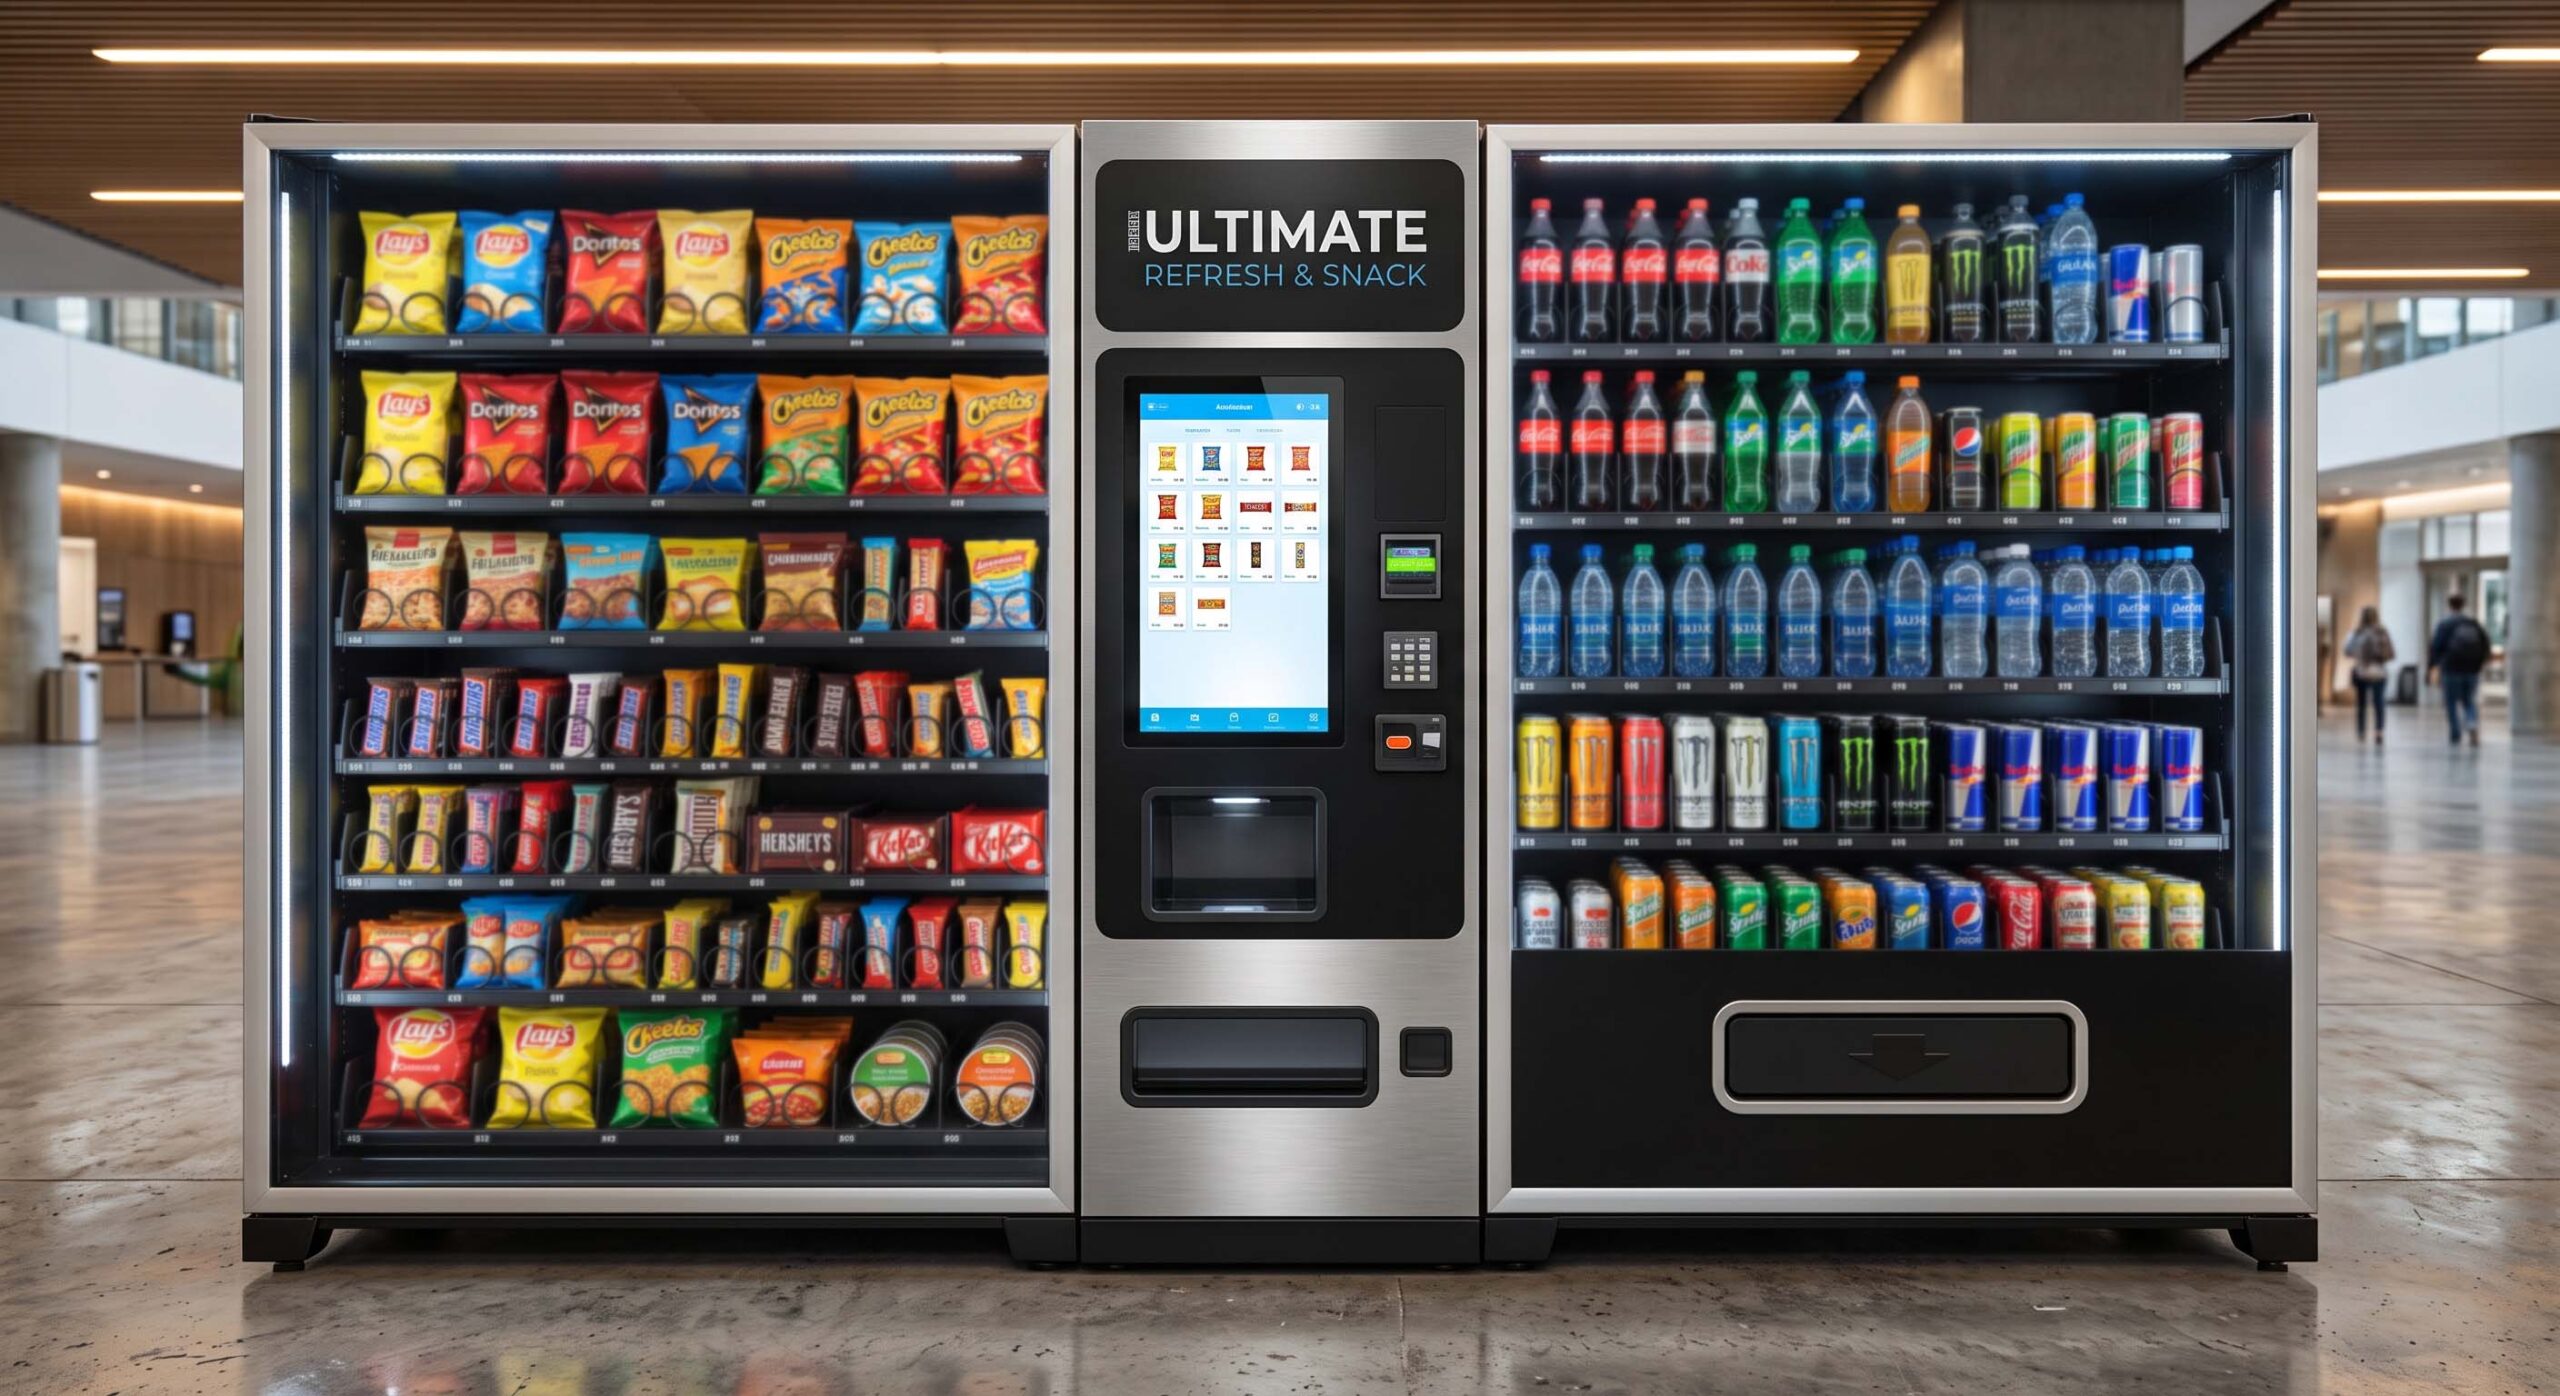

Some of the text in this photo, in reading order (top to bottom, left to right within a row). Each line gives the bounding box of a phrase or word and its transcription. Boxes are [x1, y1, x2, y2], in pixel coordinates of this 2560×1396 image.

[768, 229, 839, 267] Cheetos
[868, 230, 938, 267] Cheetos
[967, 228, 1038, 267] Cheetos
[1146, 210, 1427, 253] ULTIMATE
[1145, 264, 1427, 287] REFRESH & SNACK
[771, 388, 841, 425] Cheetos
[866, 390, 937, 427] Cheetos
[965, 389, 1036, 427] Cheetos
[625, 1017, 705, 1055] Cheetos
